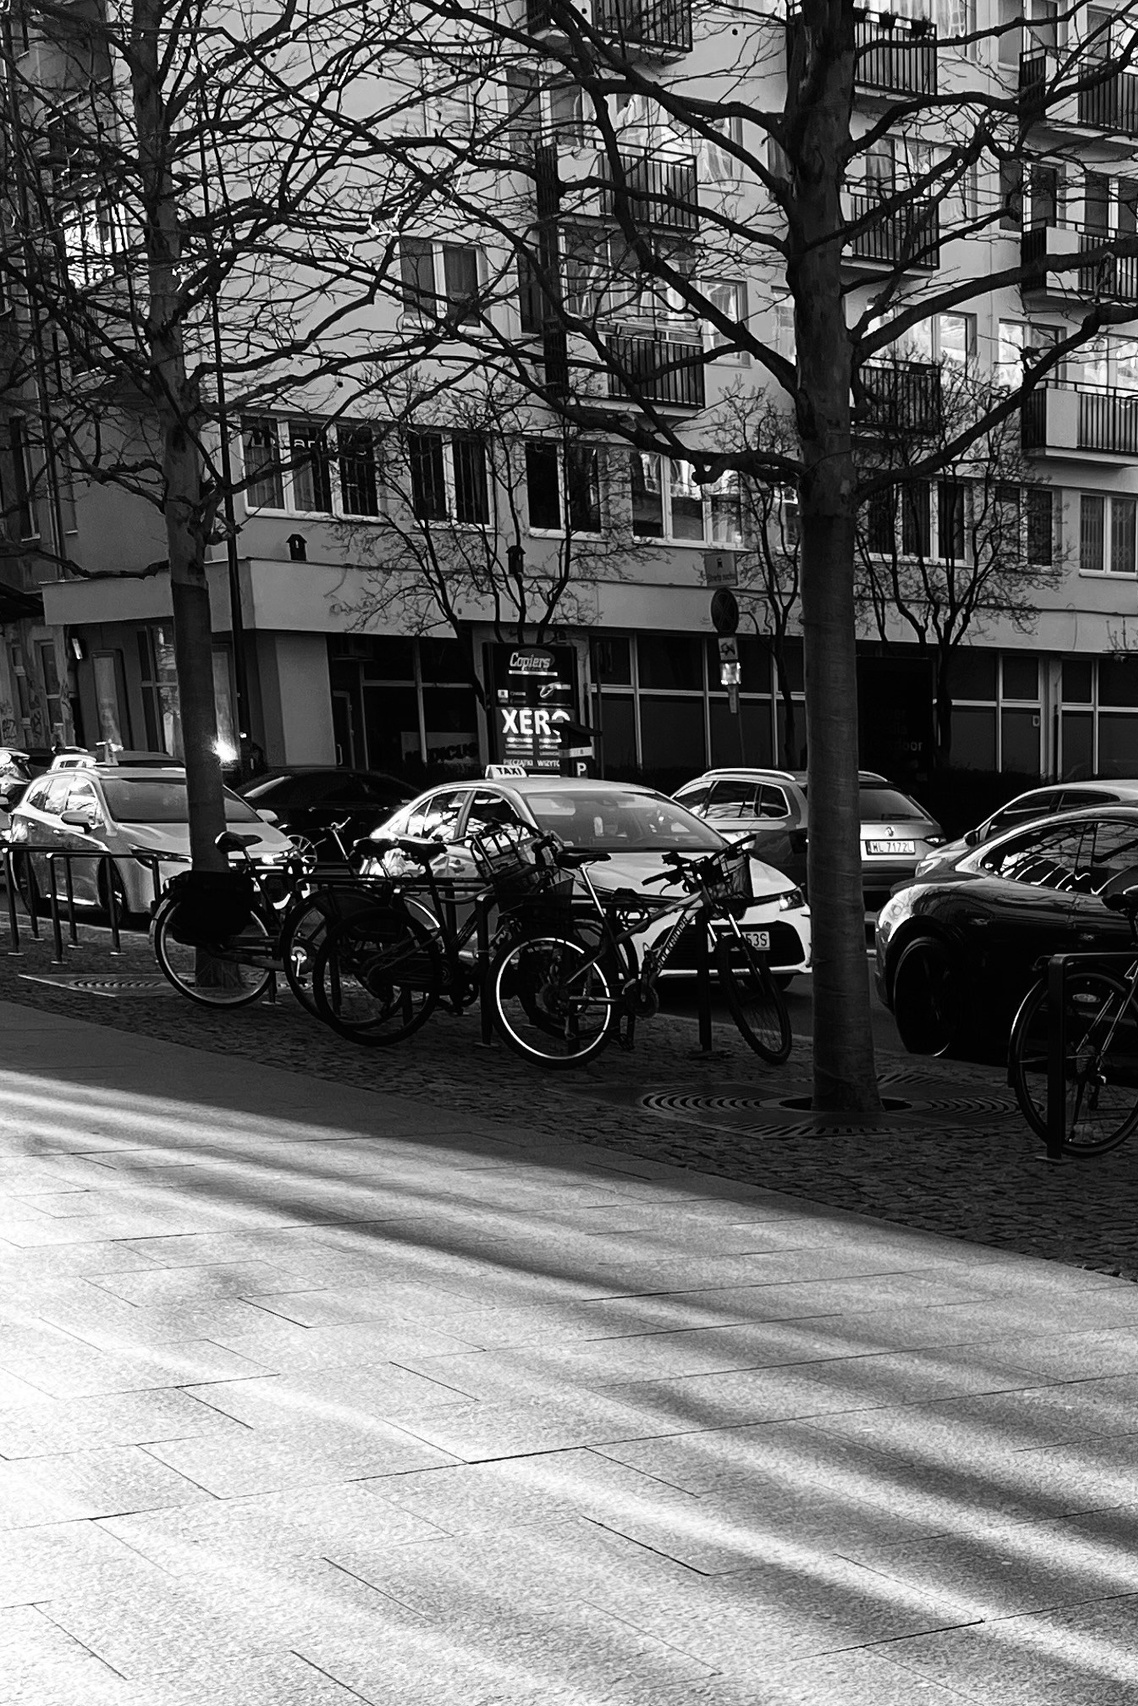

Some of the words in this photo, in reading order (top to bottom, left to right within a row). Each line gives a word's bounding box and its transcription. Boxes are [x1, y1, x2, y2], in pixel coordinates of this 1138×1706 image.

[509, 652, 551, 671] Copiers
[496, 767, 522, 775] TAXI
[576, 762, 587, 776] P
[872, 842, 884, 852] WL
